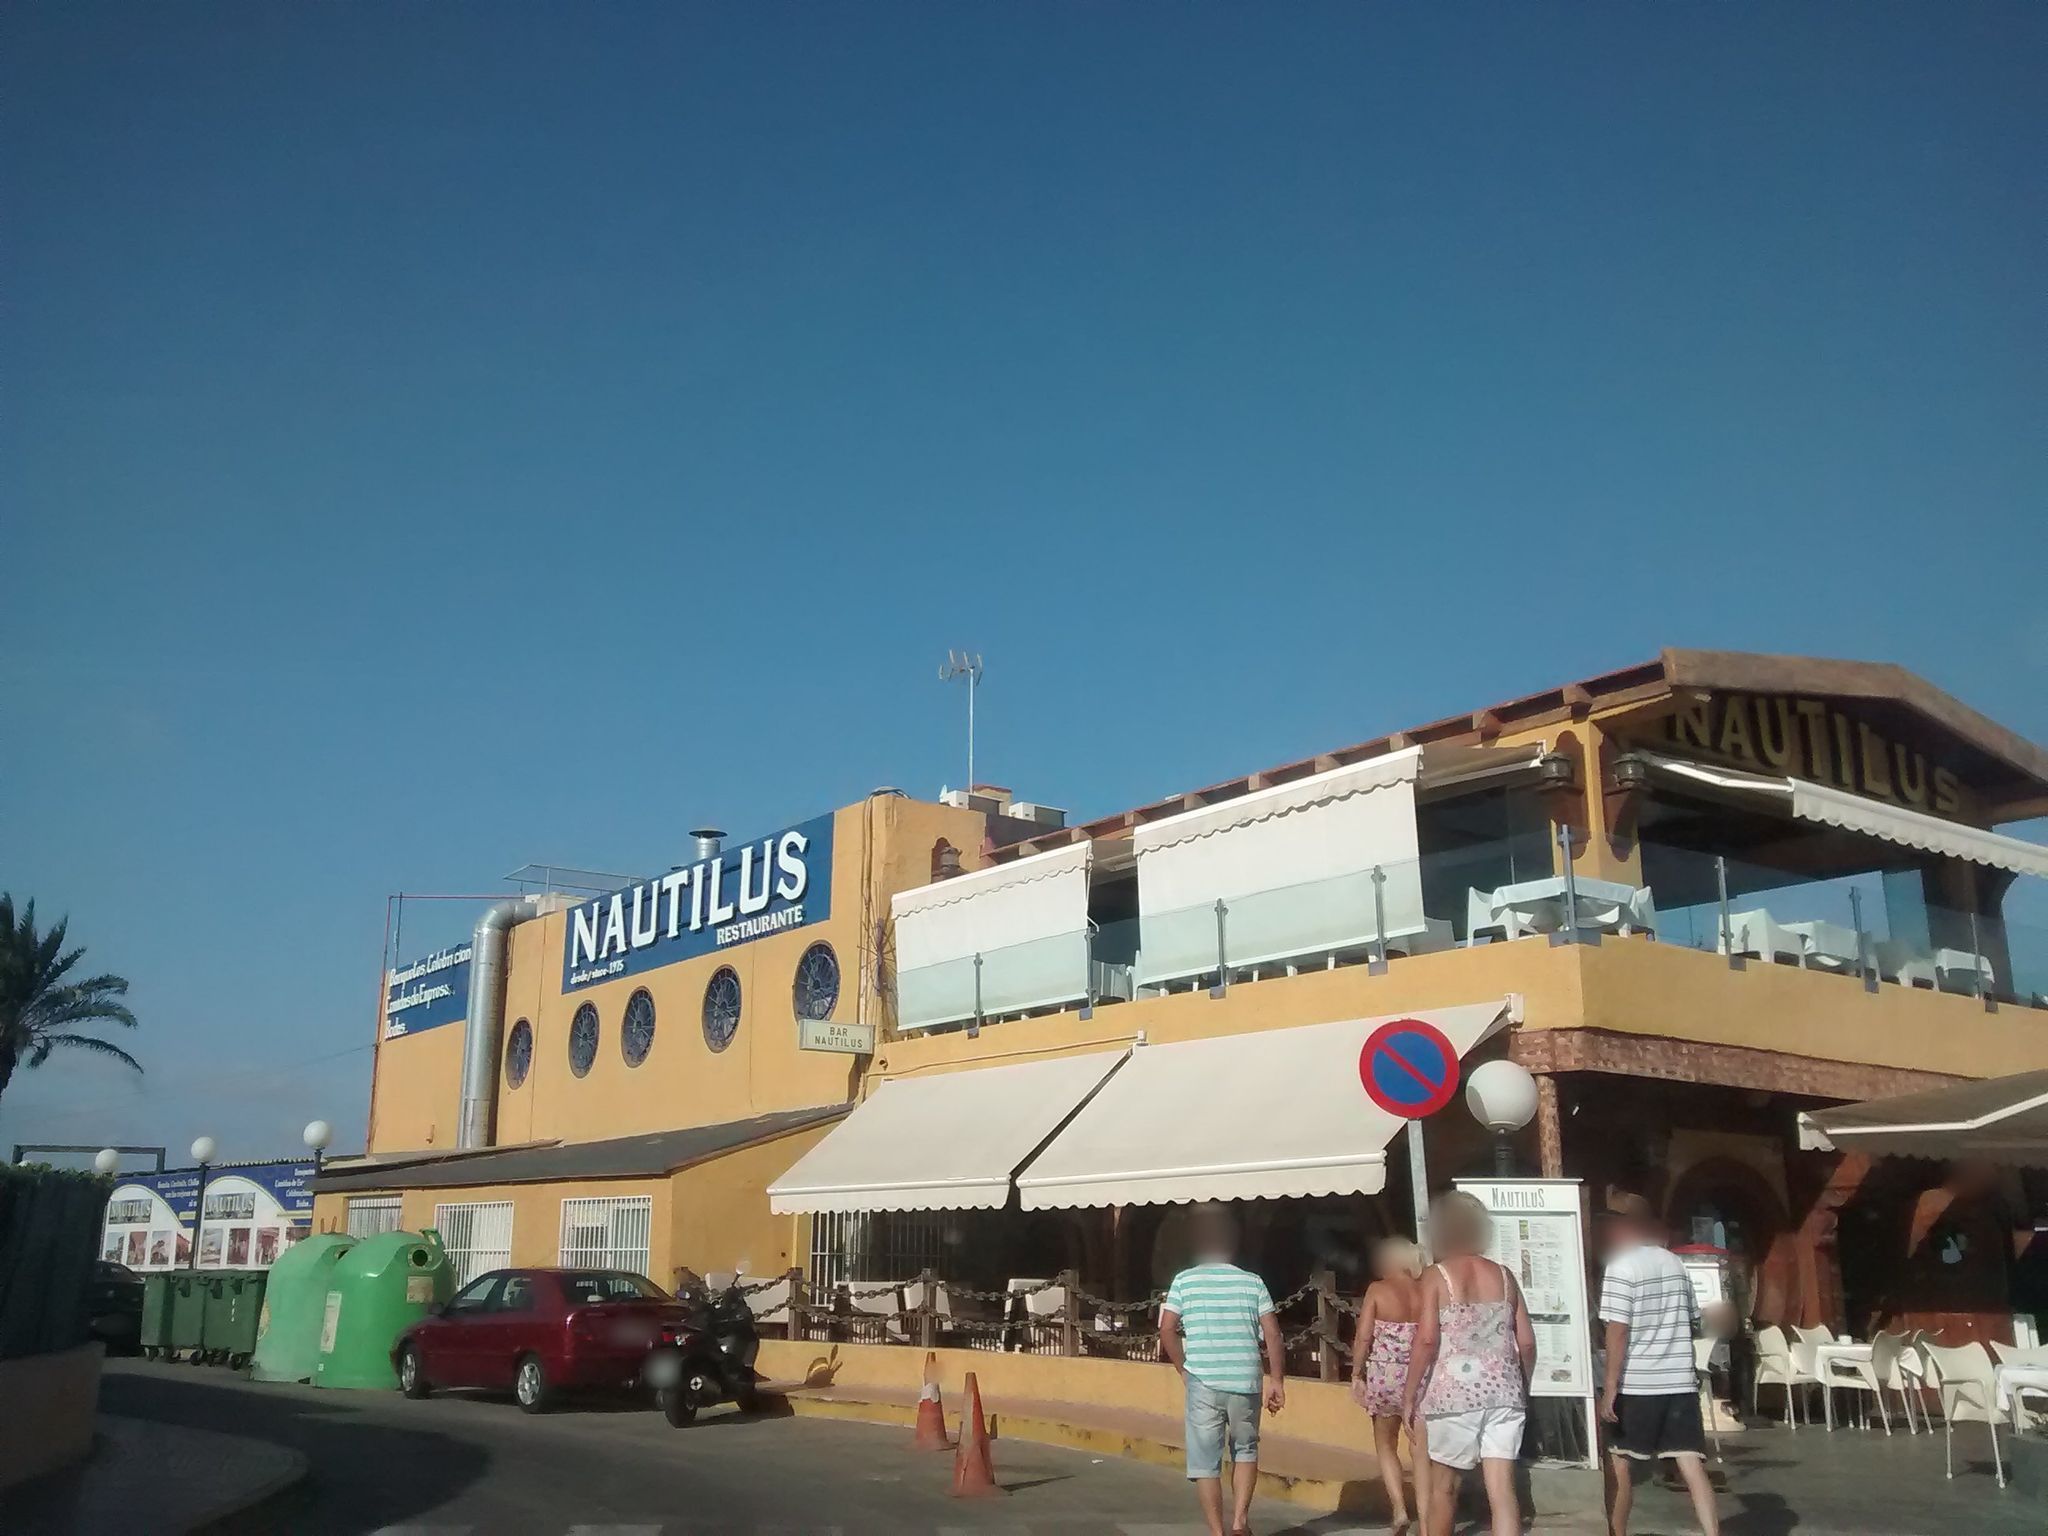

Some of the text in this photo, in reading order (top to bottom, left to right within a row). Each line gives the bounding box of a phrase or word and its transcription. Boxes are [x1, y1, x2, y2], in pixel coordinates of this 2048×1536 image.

[1675, 696, 1960, 813] NAUTILUS
[571, 831, 808, 968] NAUTILUS
[717, 904, 804, 946] RESTAURANTE
[814, 1036, 863, 1048] NAUTILUS
[829, 1026, 848, 1037] BAR
[206, 1195, 254, 1214] NAUTILUS
